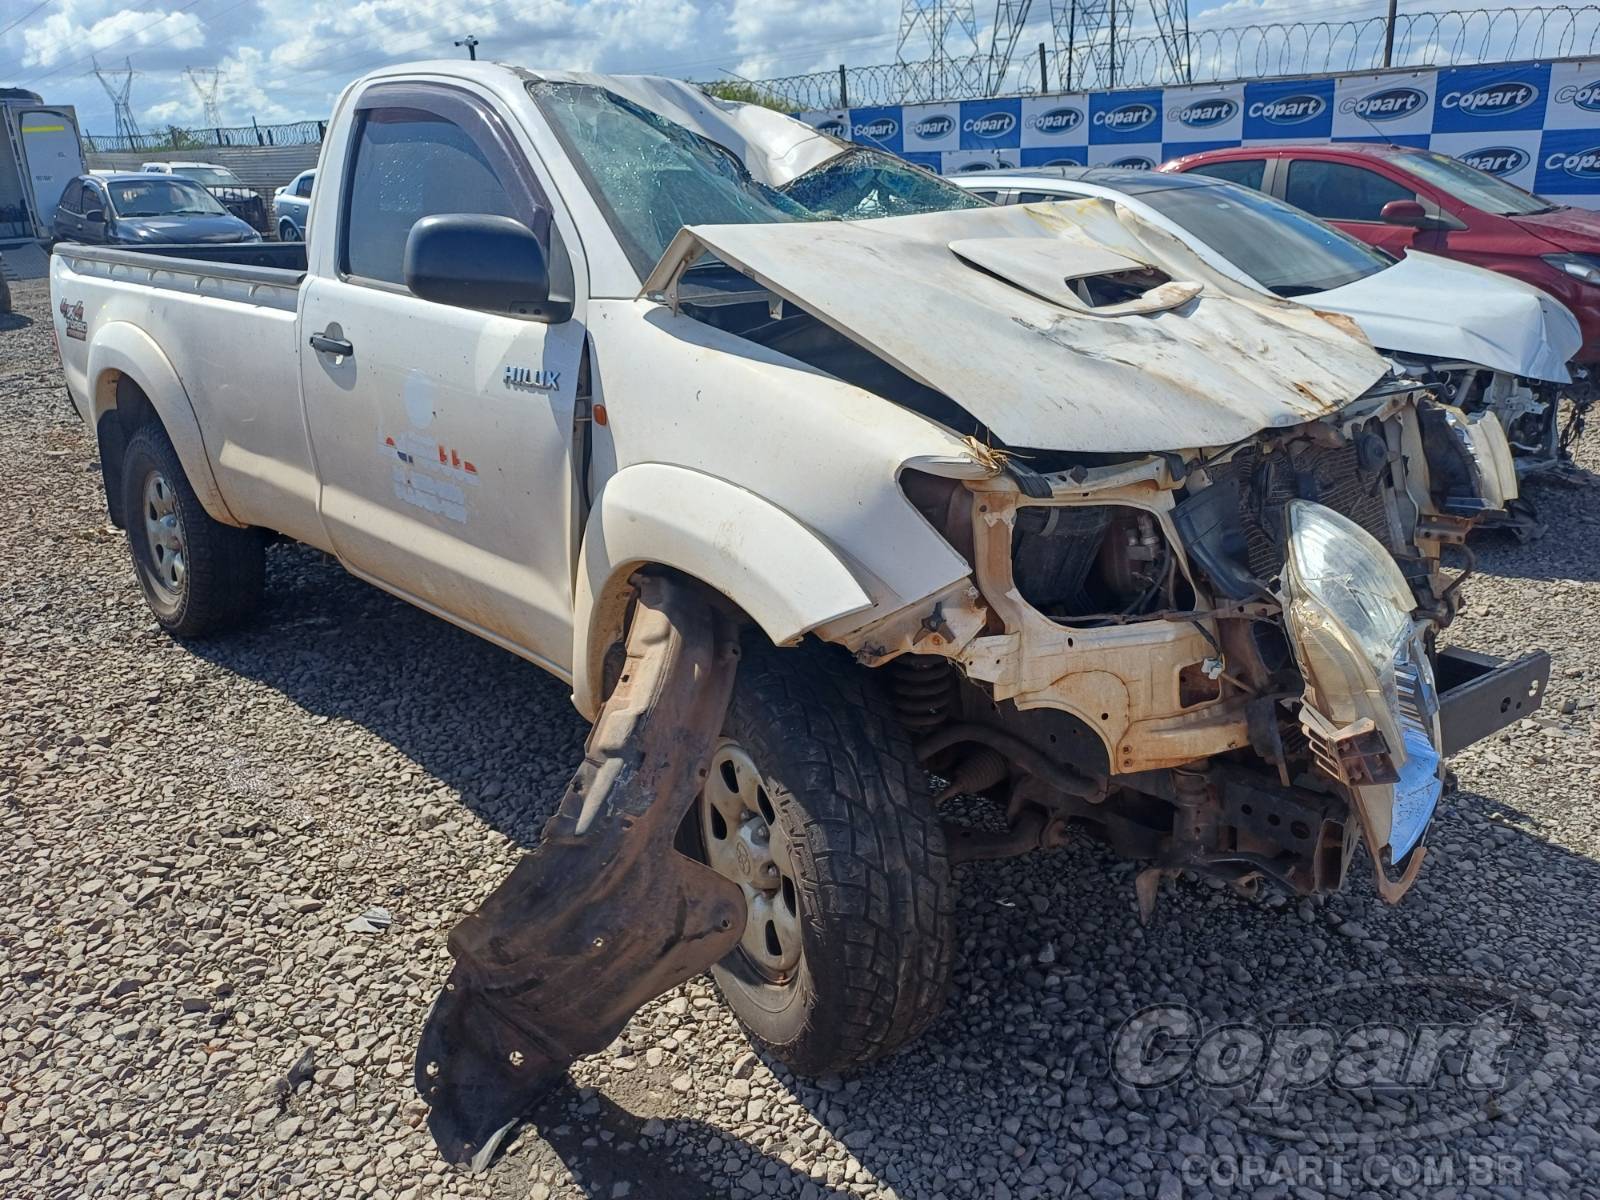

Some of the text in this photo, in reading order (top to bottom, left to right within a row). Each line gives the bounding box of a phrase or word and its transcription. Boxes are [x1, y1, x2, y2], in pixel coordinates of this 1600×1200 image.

[1338, 92, 1416, 116] Copart
[1441, 87, 1528, 110] Copart
[1554, 85, 1600, 105] Cop
[1092, 108, 1149, 126] Copart
[1167, 103, 1230, 123] Copart
[1248, 99, 1317, 119] Copart
[854, 123, 894, 136] Copart
[963, 117, 1012, 133] Copart
[1024, 112, 1078, 130] Copart
[503, 365, 561, 391] HILUX
